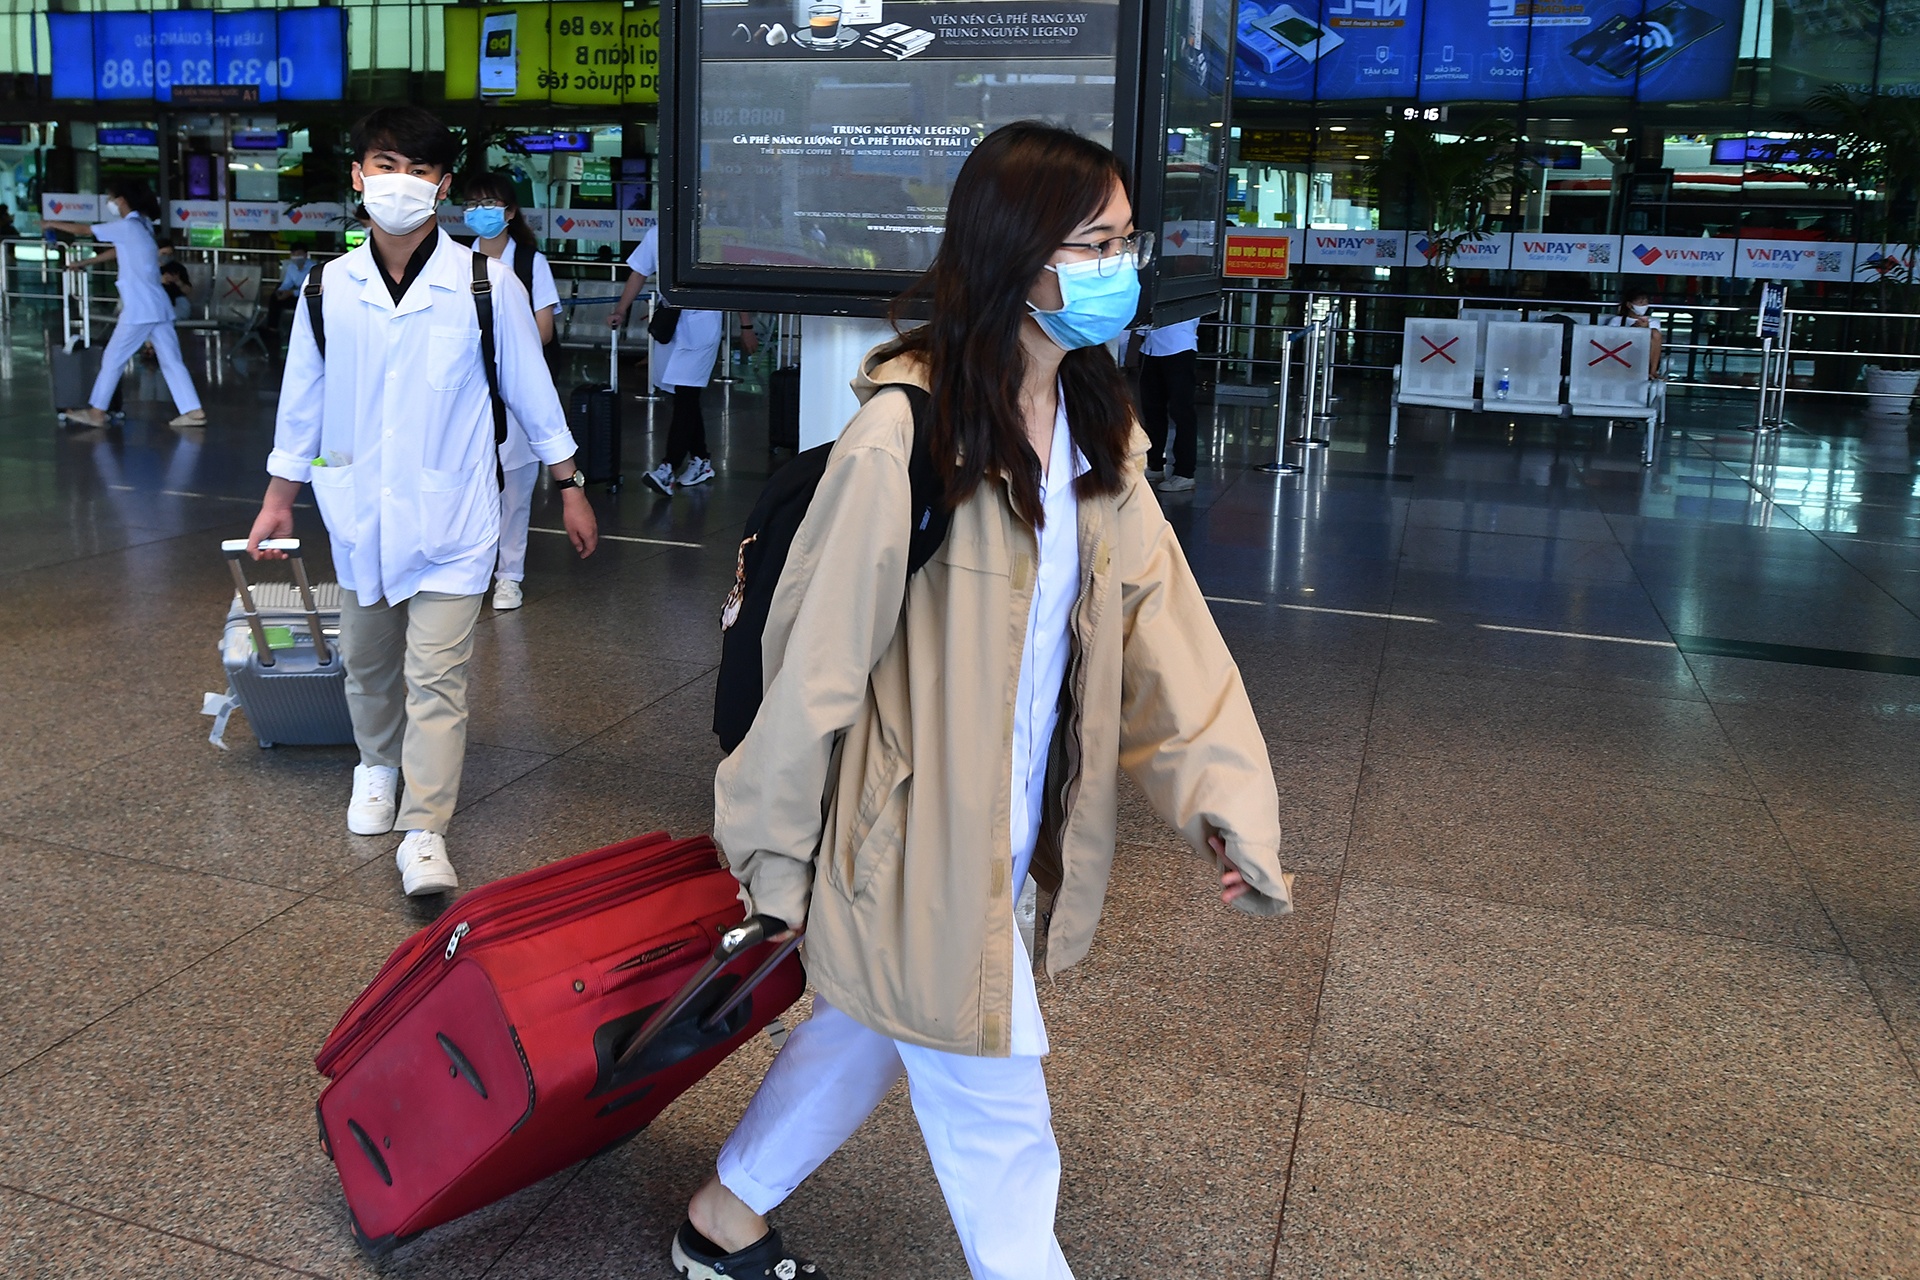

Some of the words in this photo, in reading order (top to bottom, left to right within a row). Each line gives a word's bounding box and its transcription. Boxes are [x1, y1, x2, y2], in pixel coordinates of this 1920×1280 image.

[1006, 13, 1028, 24] PHÊ
[1031, 13, 1064, 24] RANG
[1066, 13, 1088, 23] XAY
[938, 28, 978, 38] TRUNG
[982, 26, 1029, 37] NGUYÊN
[1032, 26, 1079, 37] LEGEND
[243, 90, 258, 101] A1
[832, 126, 871, 135] TRUNG
[874, 124, 920, 135] NGUYÊN
[925, 126, 970, 135] LEGEND
[749, 134, 770, 145] PHÊ
[804, 135, 842, 147] LƯỢNG
[868, 135, 889, 146] PHÊ
[891, 135, 931, 146] THÔNG
[934, 136, 961, 146] THÁI
[586, 220, 615, 228] VNPAY
[628, 217, 657, 227] VNPA
[1316, 237, 1365, 249] VNPAY
[1459, 243, 1501, 255] VNPAY
[1524, 241, 1576, 254] VNPAY
[1681, 250, 1726, 262] VNPAY
[1746, 248, 1803, 262] VNPAY
[1228, 260, 1267, 269] RESTRICTED
